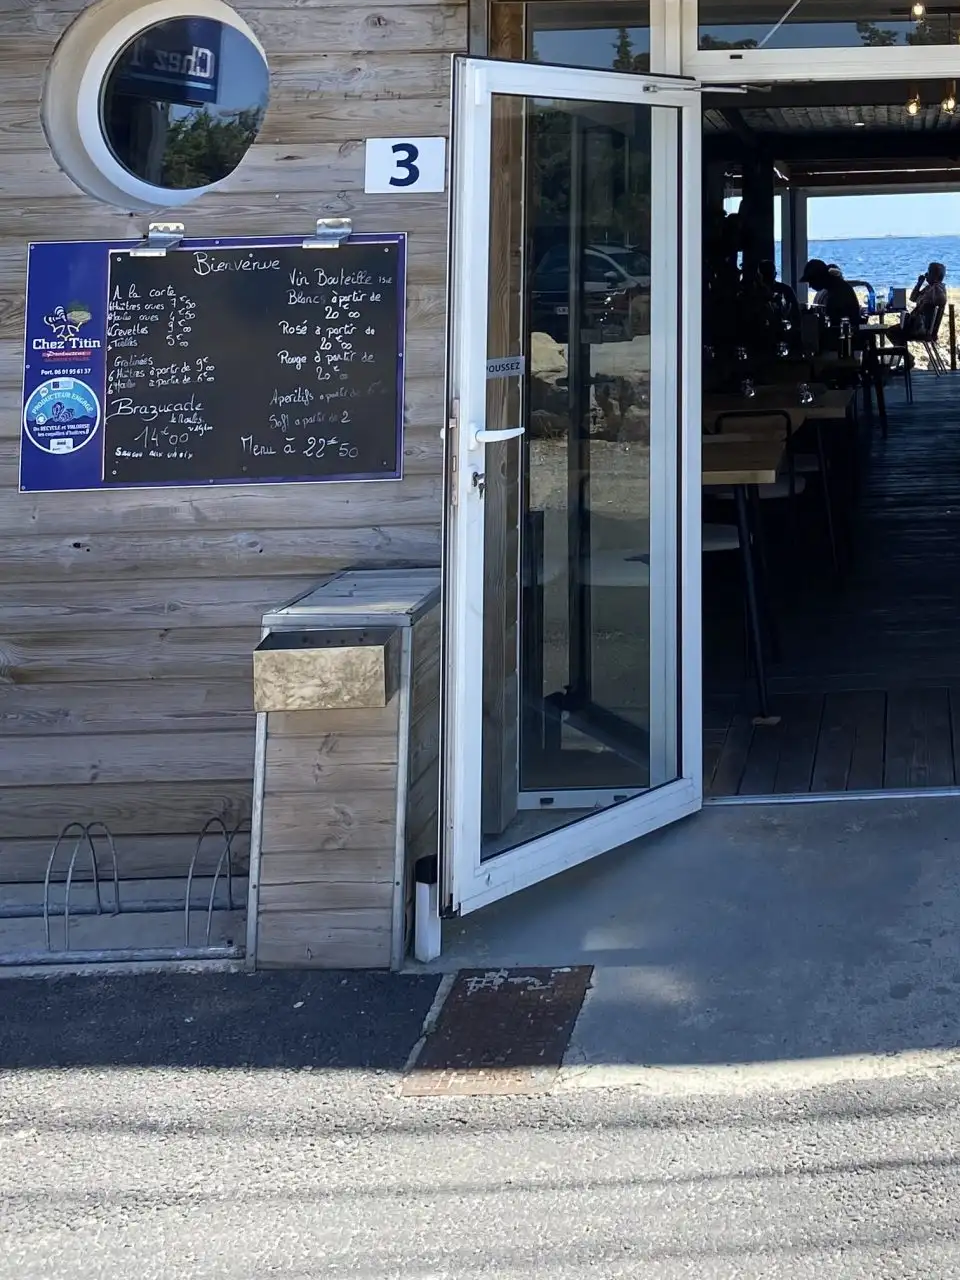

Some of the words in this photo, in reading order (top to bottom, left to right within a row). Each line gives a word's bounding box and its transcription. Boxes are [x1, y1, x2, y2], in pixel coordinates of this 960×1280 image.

[389, 143, 420, 187] 3
[193, 251, 280, 275] Bienvenue
[289, 268, 310, 286] Vin
[313, 267, 373, 286] Bouteille
[129, 284, 141, 299] la
[149, 285, 176, 297] carte
[338, 290, 367, 307] partir
[369, 292, 381, 302] de
[278, 320, 308, 335] Rosé
[326, 323, 357, 338] partir
[365, 326, 375, 335] de
[33, 338, 64, 350] Chez
[69, 337, 101, 349] Titin
[181, 362, 191, 373] de
[277, 350, 307, 370] Rouge
[325, 351, 357, 365] partir
[487, 362, 520, 373] OUSSEZ
[106, 393, 204, 421] Brazucade
[241, 434, 277, 456] Menu
